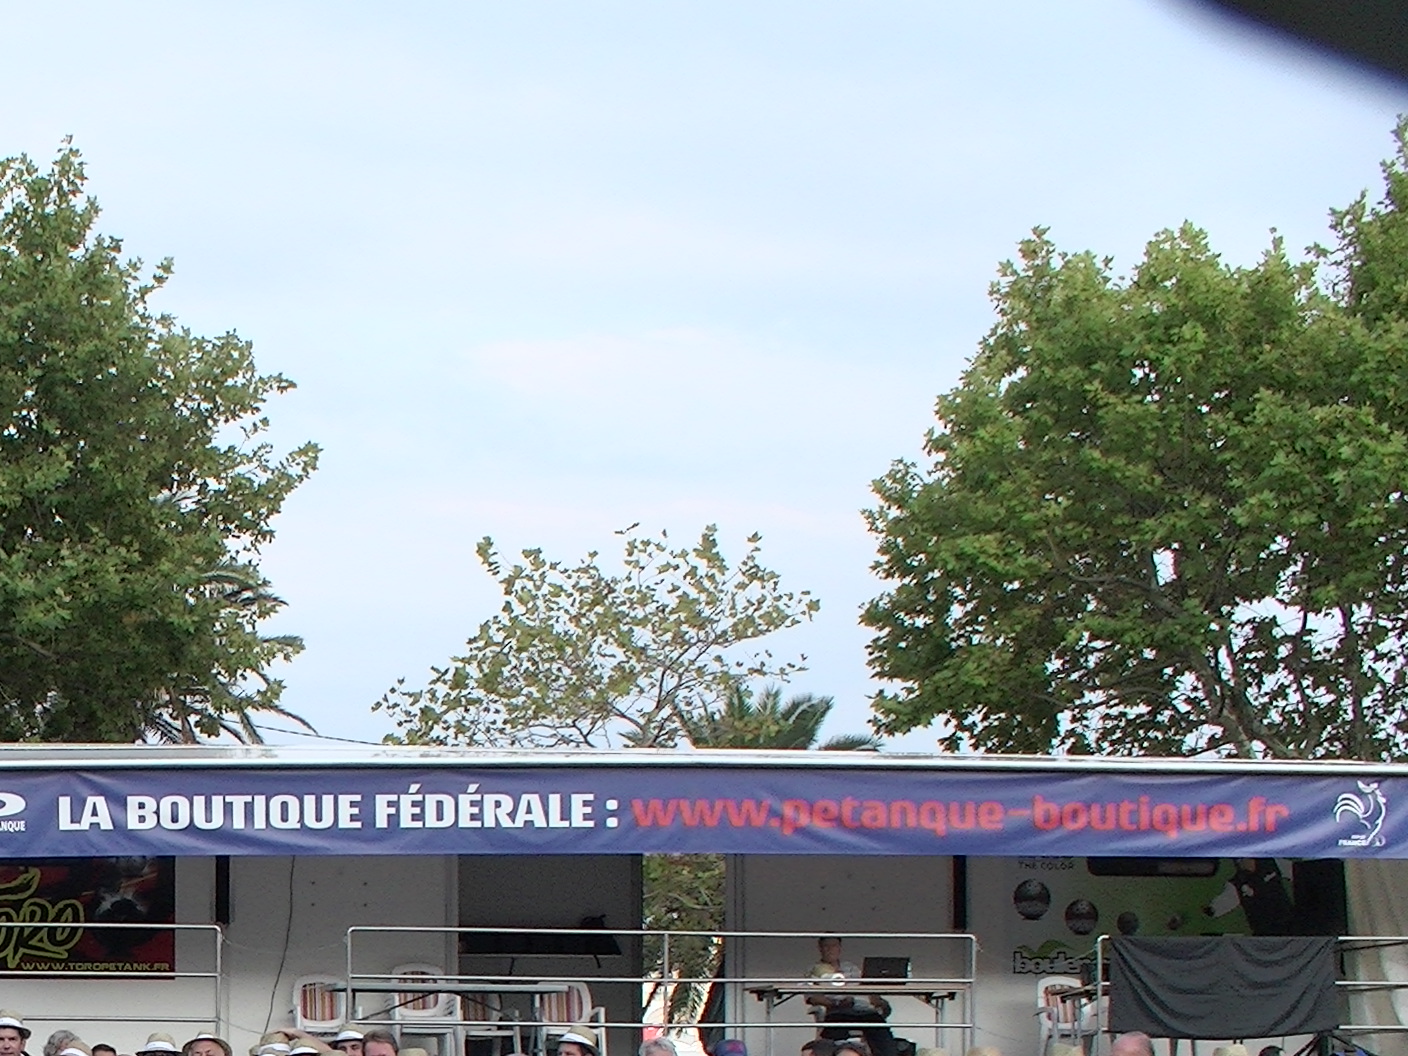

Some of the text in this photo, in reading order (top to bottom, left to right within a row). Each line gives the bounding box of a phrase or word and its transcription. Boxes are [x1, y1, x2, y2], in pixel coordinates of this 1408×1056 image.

[58, 795, 114, 831] LA
[126, 794, 362, 831] BOUTIQUE
[374, 783, 596, 828] FÉDÉRALE
[629, 794, 1290, 839] www.petanque-boutique.fr
[20, 961, 170, 972] WWW.TOROPETANK.FR
